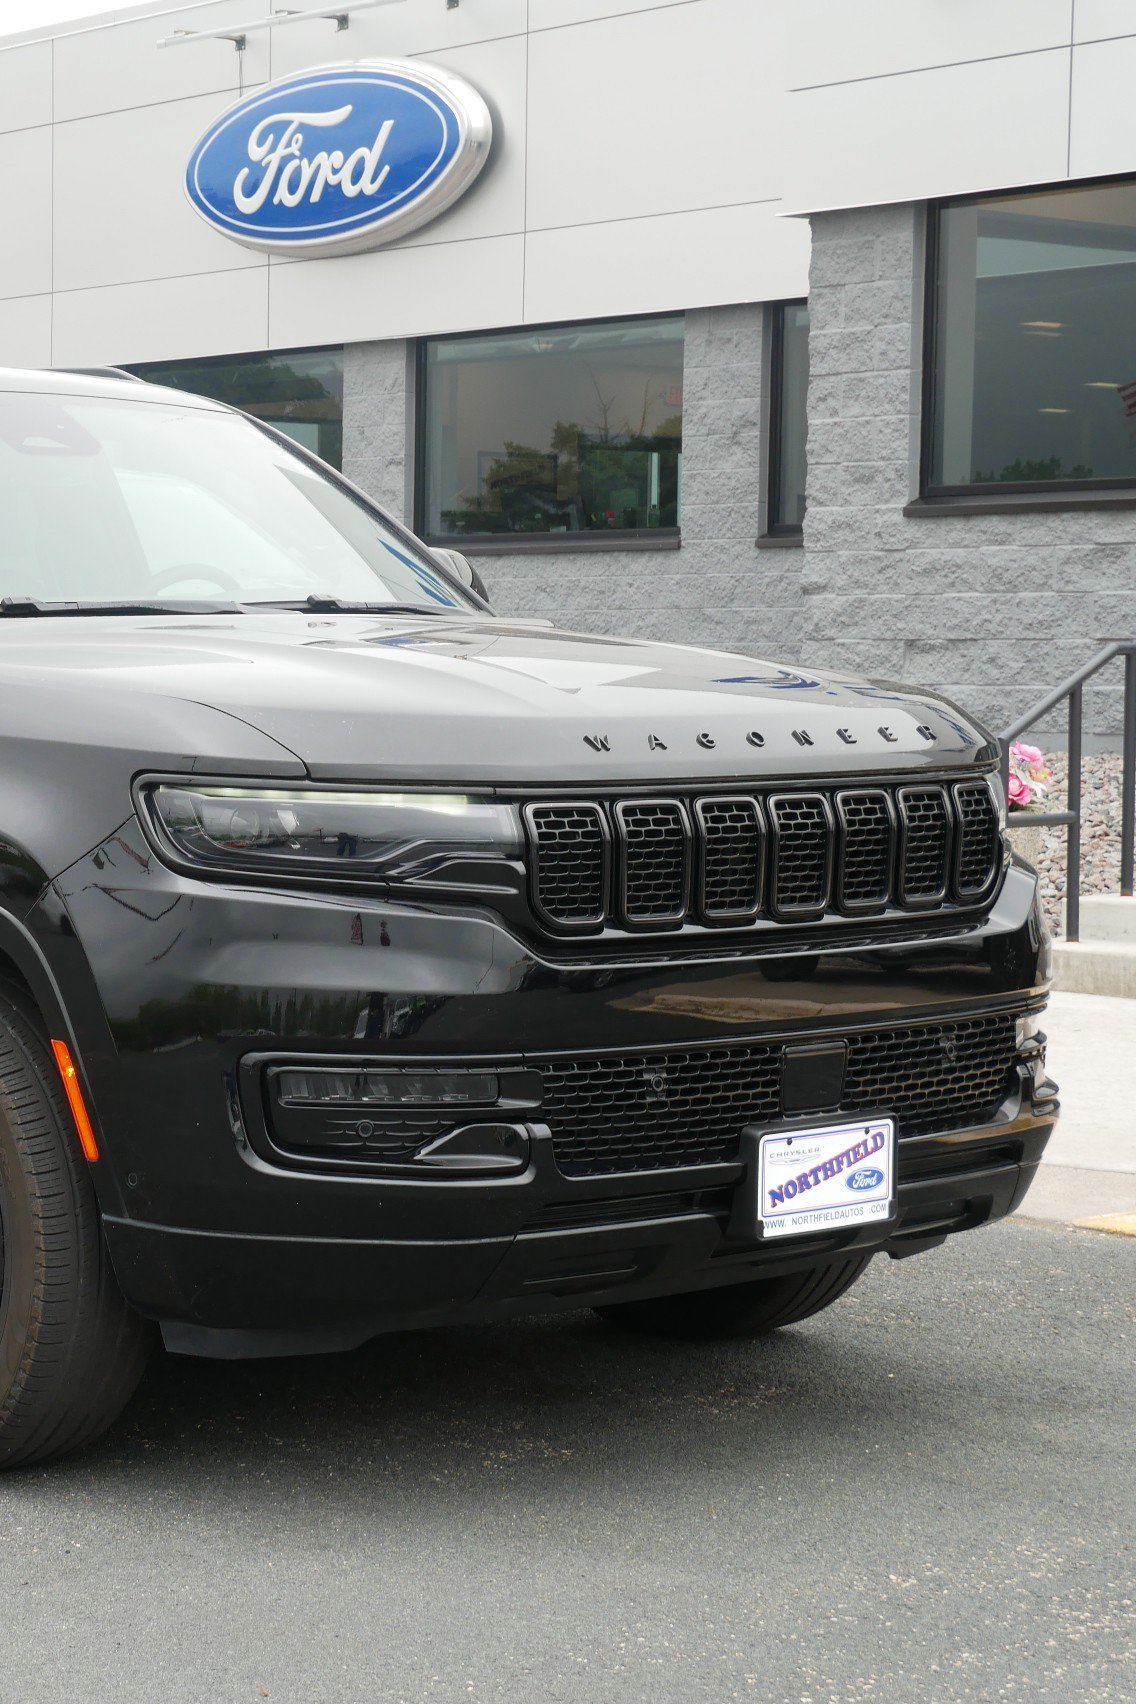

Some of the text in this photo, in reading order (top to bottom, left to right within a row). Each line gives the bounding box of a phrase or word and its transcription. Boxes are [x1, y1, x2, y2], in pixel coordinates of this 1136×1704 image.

[233, 104, 395, 215] Ford
[582, 724, 938, 752] WAGONEER
[769, 1147, 820, 1159] CHRYSLER
[768, 1131, 885, 1208] NORTHFIELD
[852, 1171, 878, 1187] Ford
[791, 1206, 864, 1226] NORTHFIELDAUTOS
